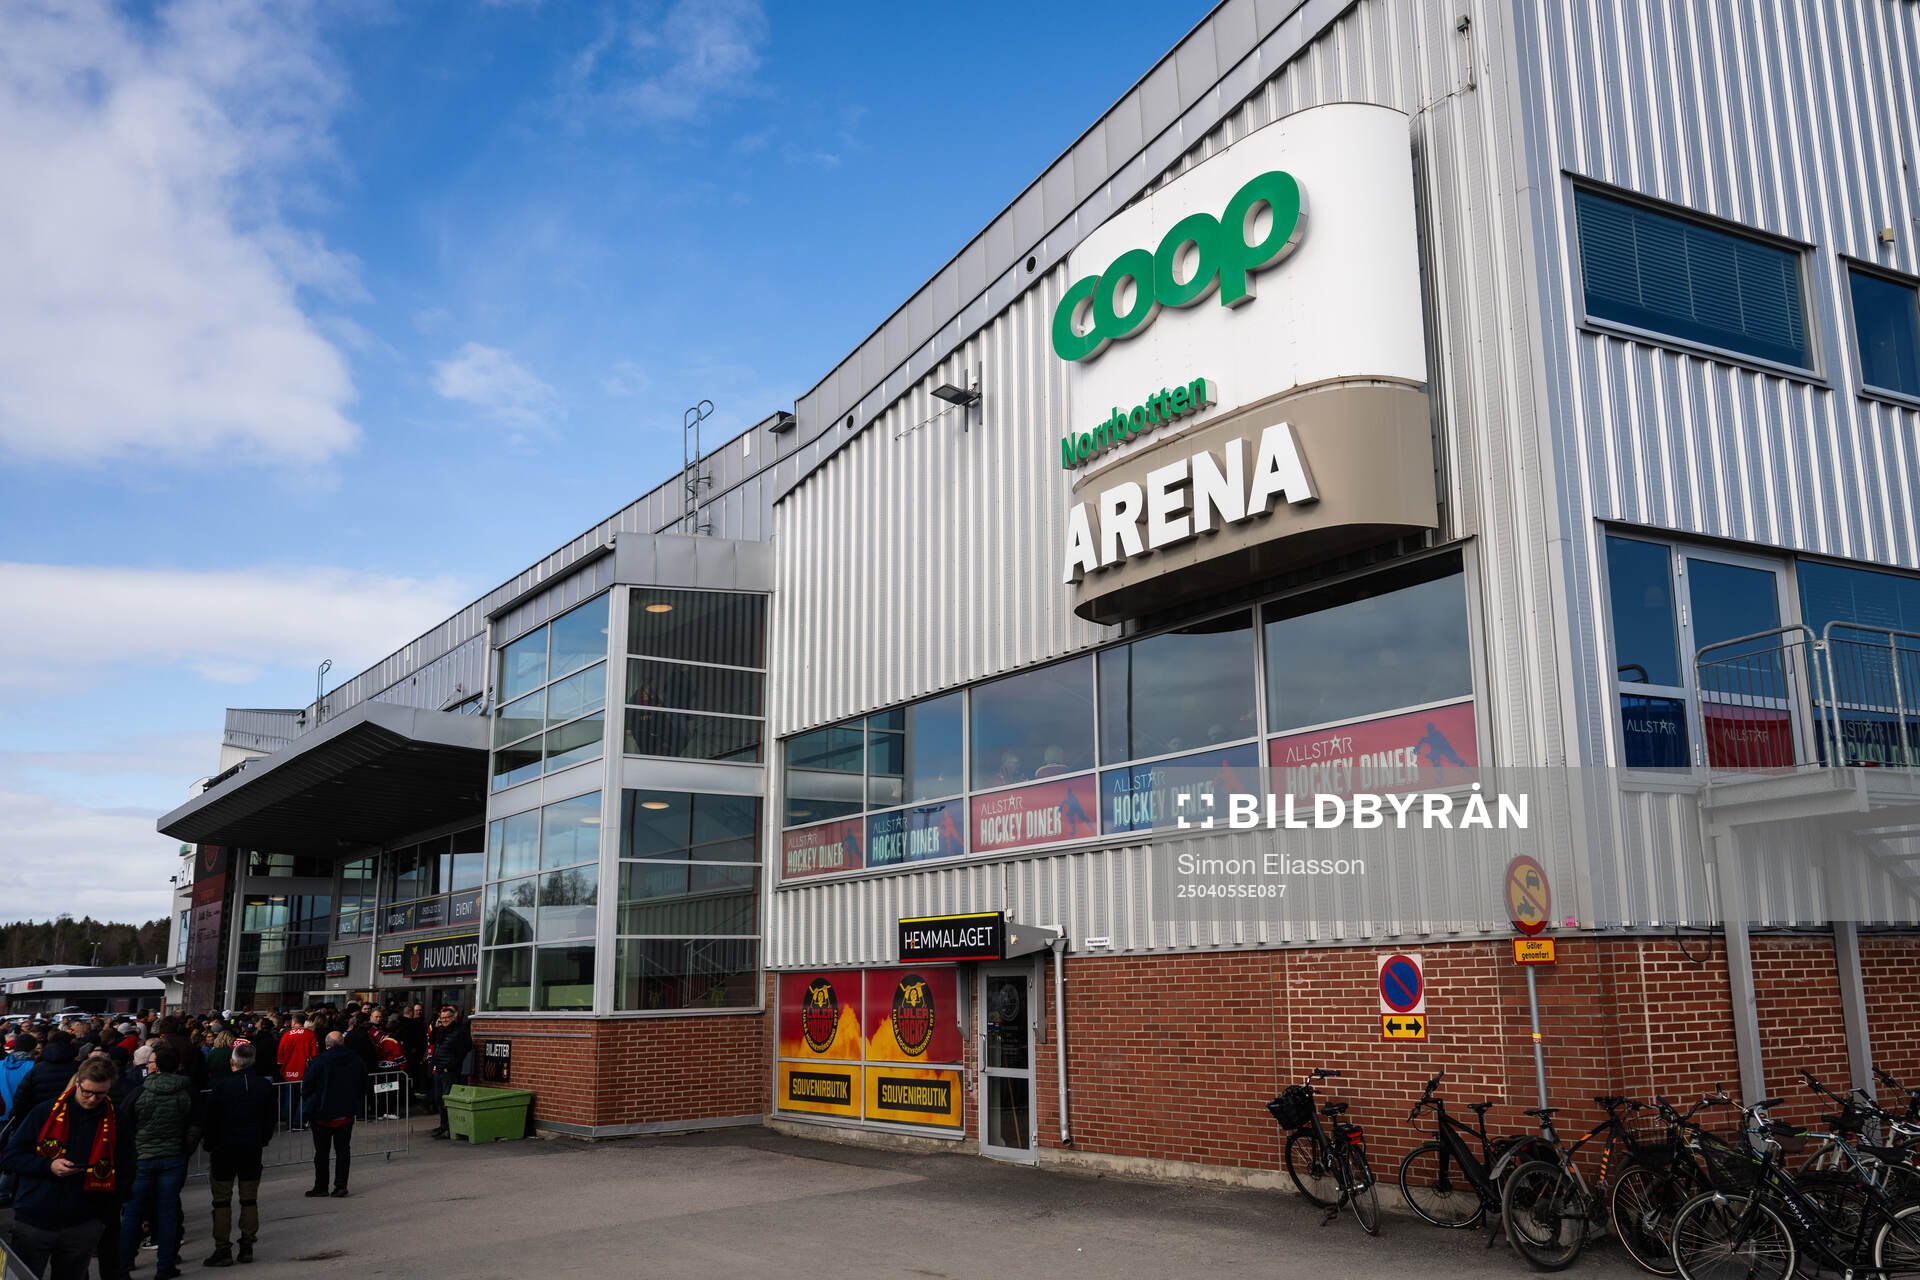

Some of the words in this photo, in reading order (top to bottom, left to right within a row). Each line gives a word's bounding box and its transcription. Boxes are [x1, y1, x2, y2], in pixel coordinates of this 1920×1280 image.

[1052, 170, 1307, 362] coop
[1061, 376, 1211, 470] Norrbotten
[1063, 421, 1317, 584] ARENA
[1627, 718, 1676, 735] ALLSTAR
[1286, 734, 1353, 763] ALLSTAR
[1114, 771, 1165, 793] ALLSTAR
[1287, 757, 1353, 799] HOCKEY
[1360, 746, 1420, 790] DINER
[981, 794, 1023, 816] ALLSTAR
[1113, 789, 1165, 827] HOCKEY
[1172, 781, 1216, 817] DINER
[873, 816, 908, 834] ALLSTAR
[980, 812, 1023, 846] HOCKEY
[1026, 806, 1062, 840] DINER
[872, 832, 907, 861] HOCKEY
[910, 826, 940, 854] DINER
[787, 846, 816, 873] HOCKEY
[819, 842, 844, 868] DINER
[455, 901, 473, 917] EVENT
[904, 926, 993, 950] HEMMALAGET
[485, 1043, 510, 1057] BILJETTER
[792, 1078, 848, 1099] SOUVENIRBUTIK
[882, 1084, 947, 1107] SOUVENIRBUTIK
